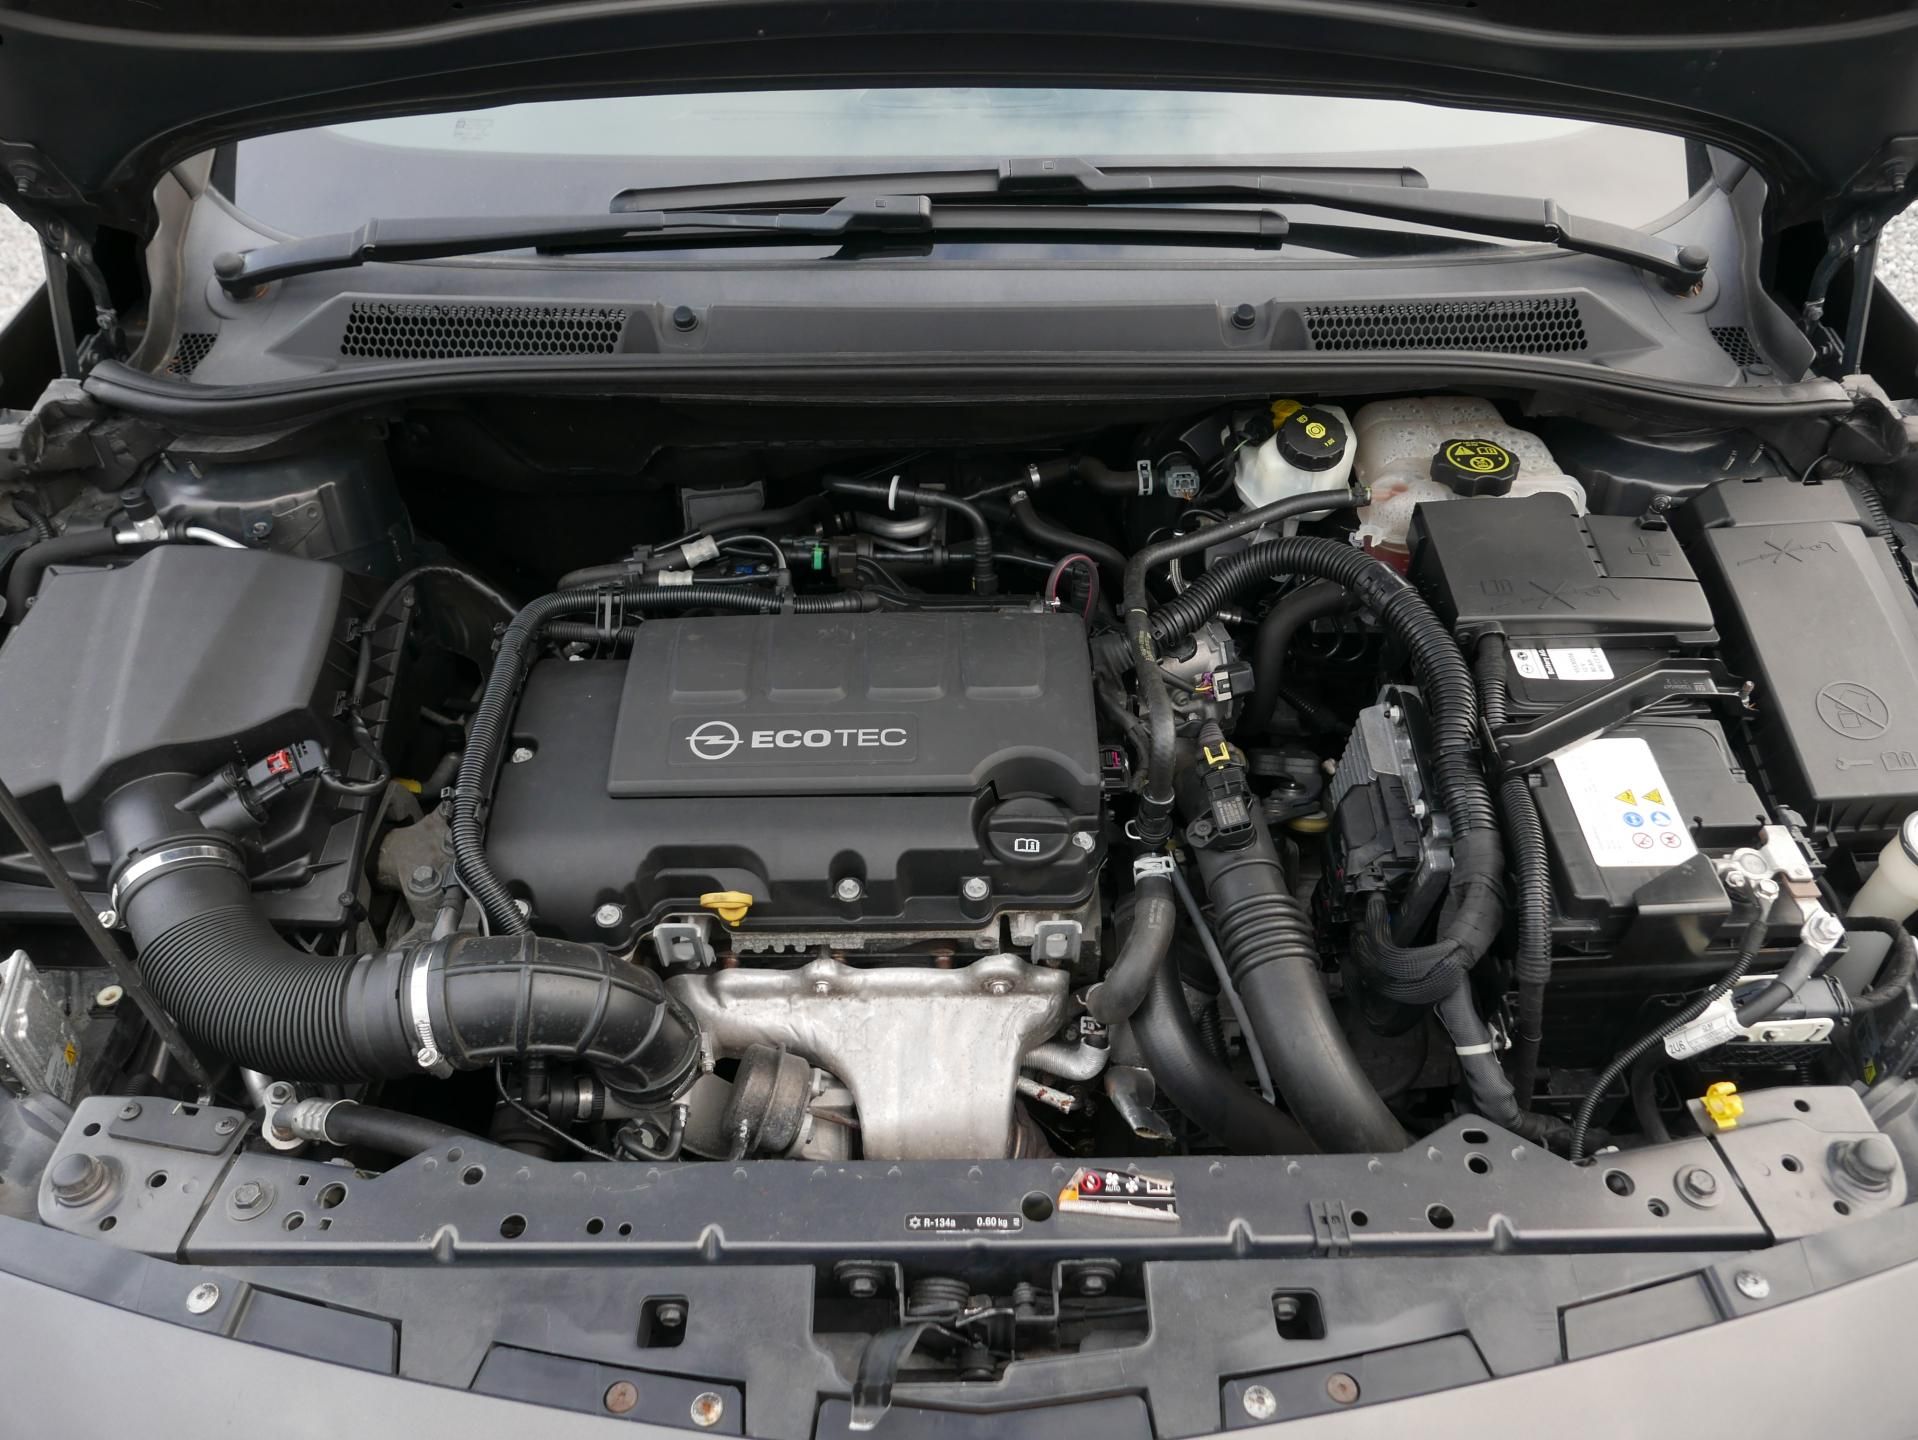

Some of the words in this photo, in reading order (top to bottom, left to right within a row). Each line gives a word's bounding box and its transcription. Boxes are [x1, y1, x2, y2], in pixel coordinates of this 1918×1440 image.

[751, 728, 907, 748] ECOTEC
[1105, 1184, 1121, 1192] AUTO
[923, 1217, 956, 1228] R-134a
[976, 1216, 997, 1227] 0.60
[998, 1217, 1008, 1228] kg
